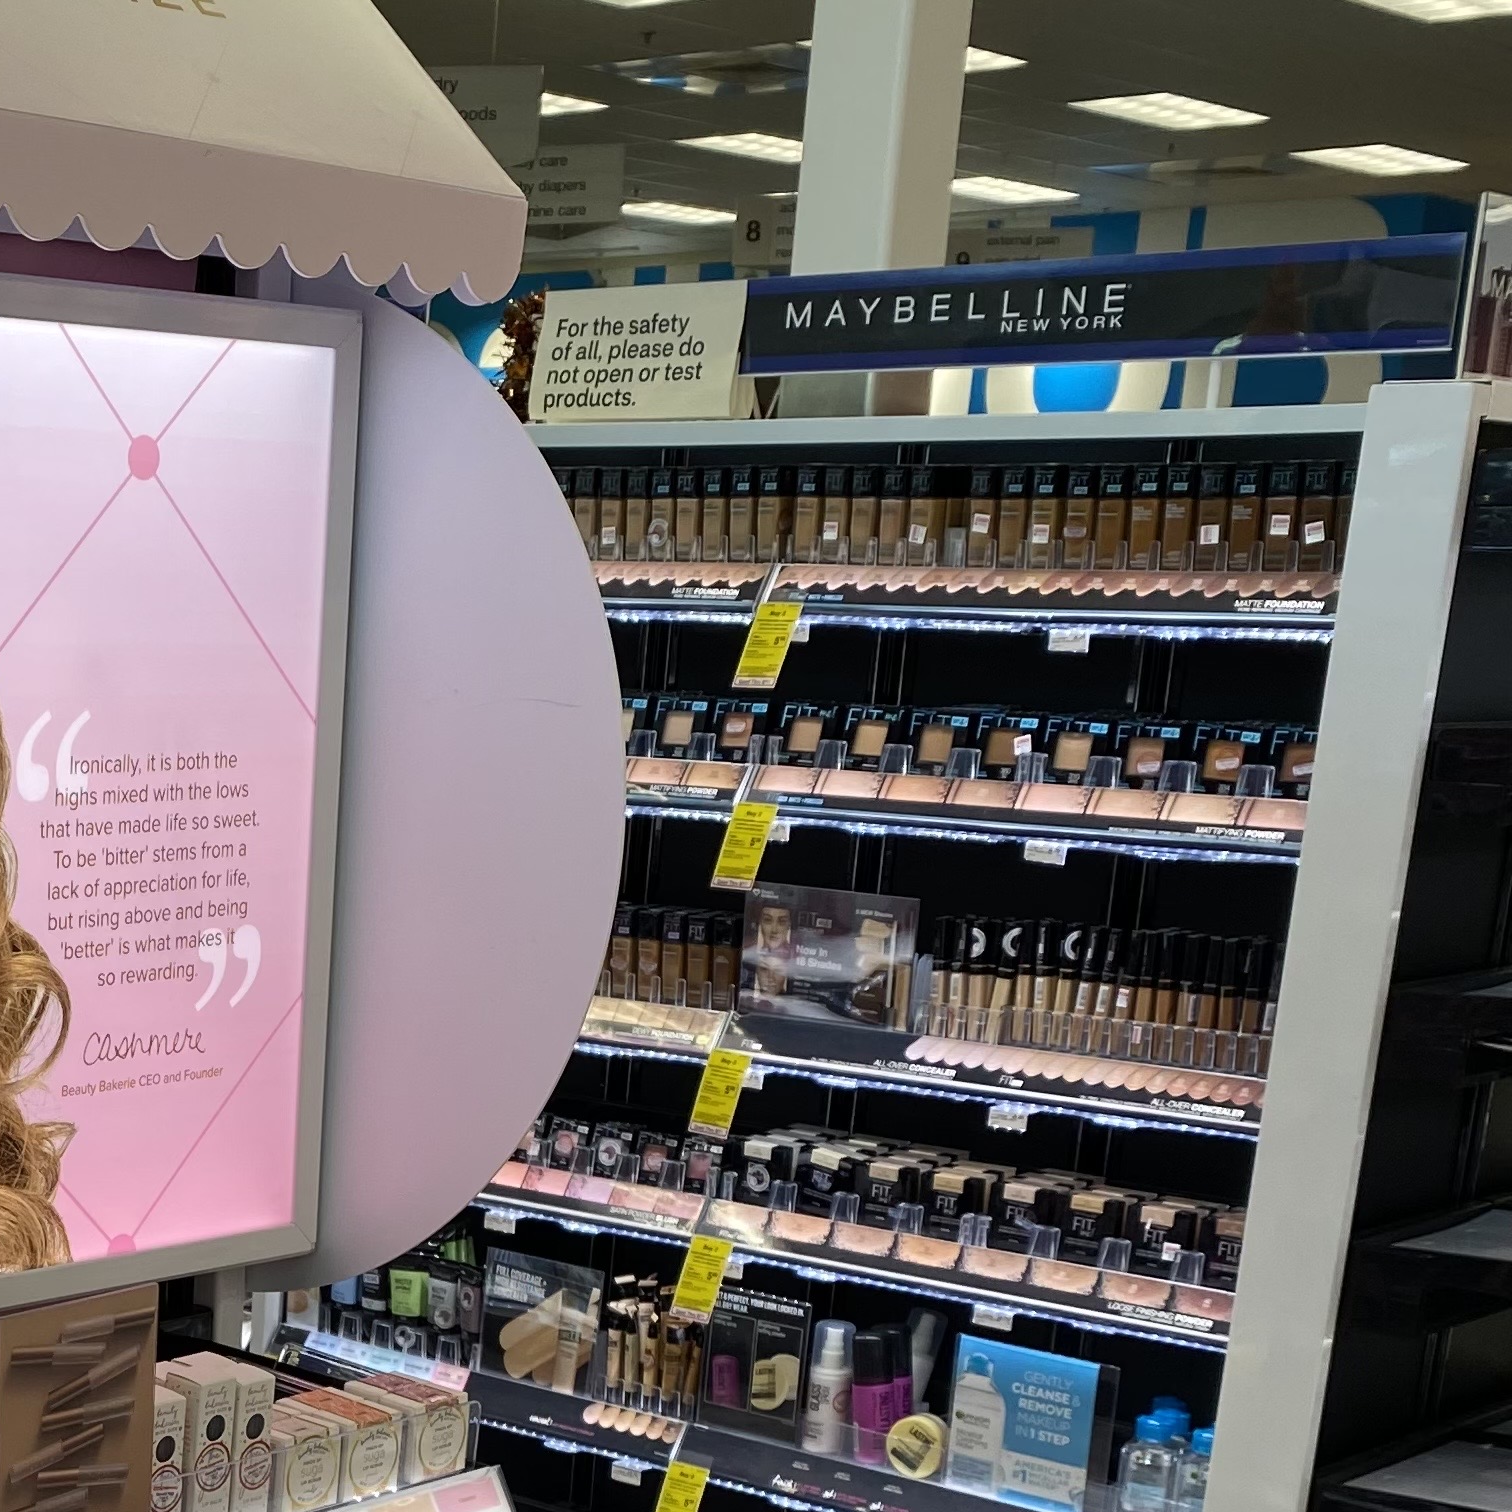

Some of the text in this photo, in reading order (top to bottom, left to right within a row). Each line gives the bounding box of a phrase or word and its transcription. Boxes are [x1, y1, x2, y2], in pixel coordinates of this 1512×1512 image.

[747, 219, 761, 242] 8
[786, 283, 1127, 329] MAYBELLINE
[557, 313, 691, 338] For the safety
[1000, 314, 1123, 333] NEW YORK
[551, 337, 705, 364] of all, please do
[547, 362, 702, 390] not open or test
[543, 387, 637, 413] products.
[69, 750, 238, 778] Ironically, it is both the
[54, 780, 249, 810] highs mixed with the lows
[39, 812, 260, 839] that have made life so sweet.
[53, 841, 248, 869] To be 'bitter' stems from a
[47, 870, 251, 901] lack of appreciation for life,
[47, 900, 249, 932] but rising above and being
[60, 928, 236, 961] 'better' is what makes it
[97, 963, 199, 988] so rewarding.
[61, 1065, 224, 1099] Beauty Bakerie CEO and Founder
[1012, 1382, 1071, 1405] CLEANSE
[1024, 1371, 1074, 1389] GENTLY
[1018, 1397, 1072, 1420] REMOVE
[1037, 1429, 1071, 1446] STEP
